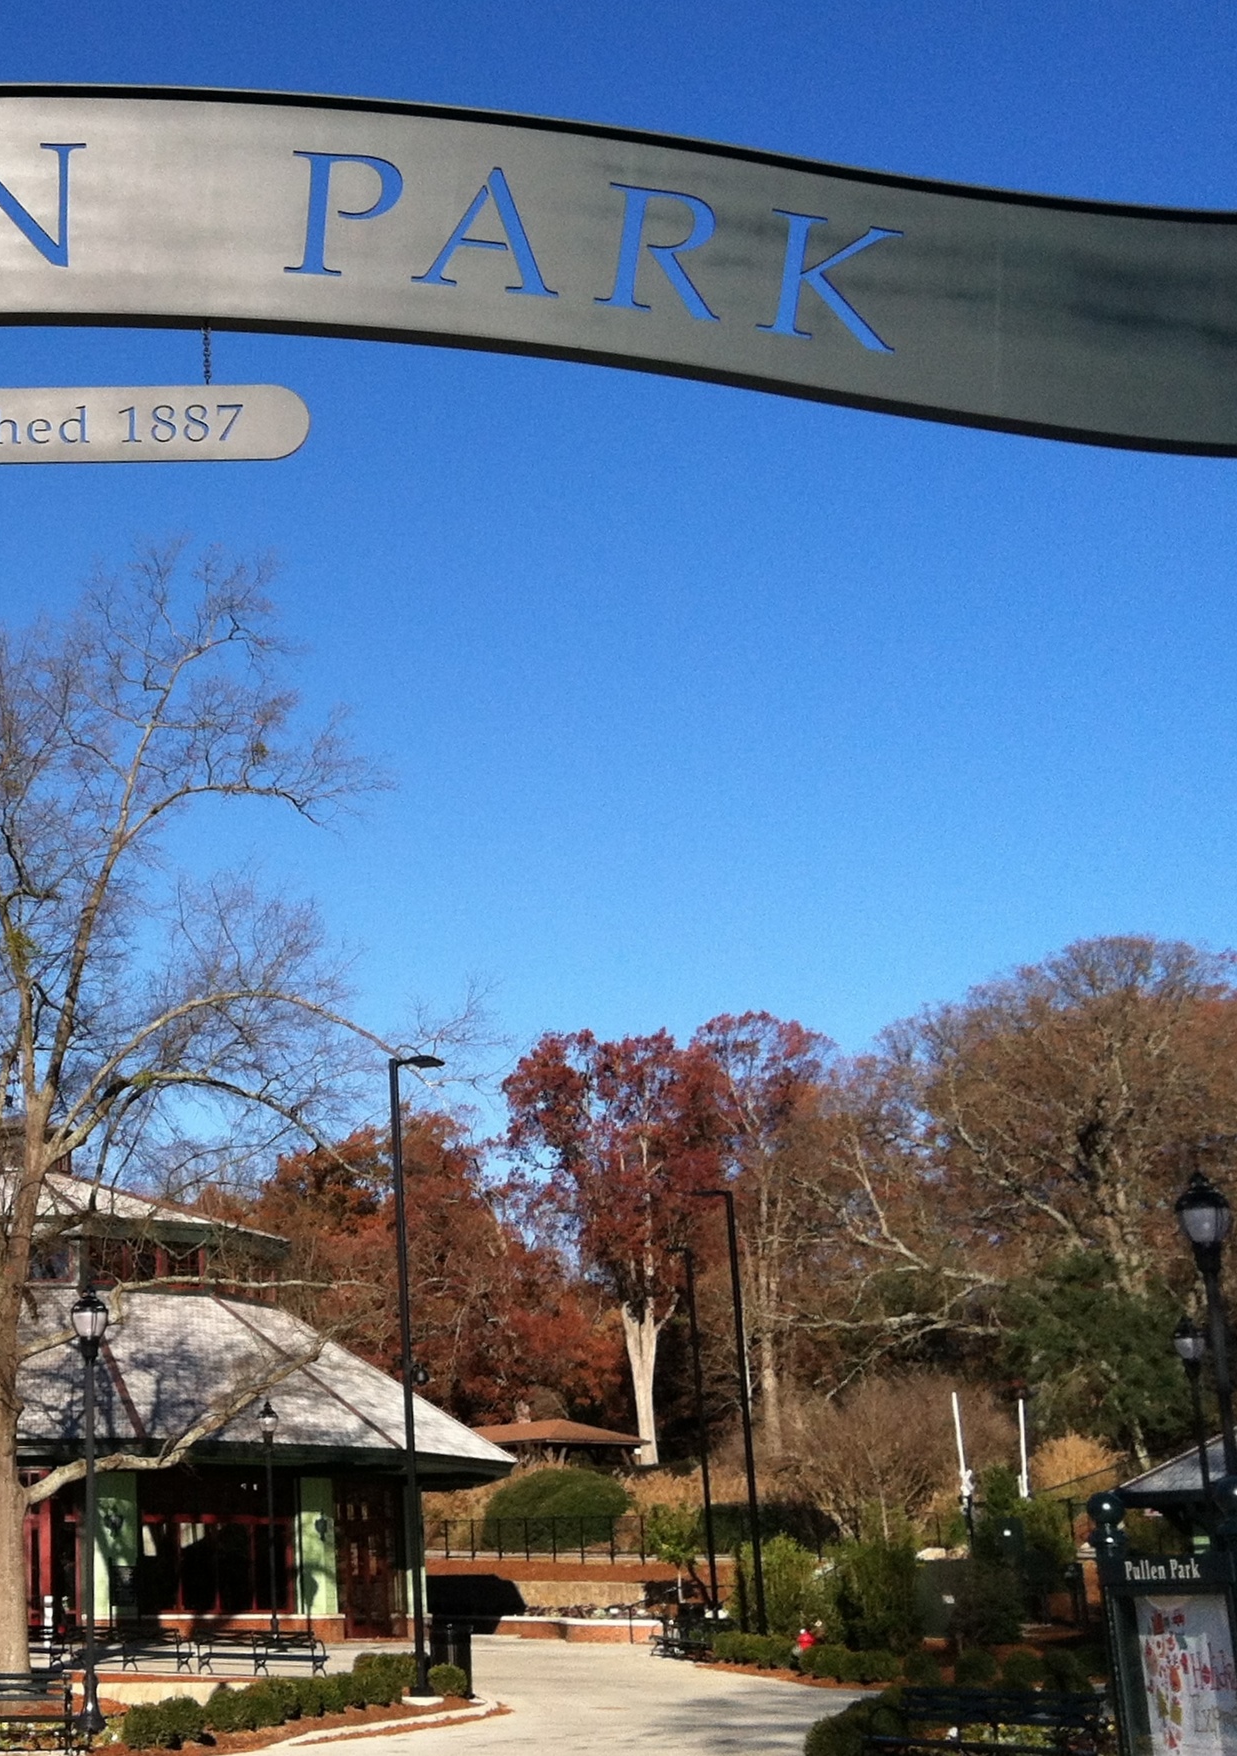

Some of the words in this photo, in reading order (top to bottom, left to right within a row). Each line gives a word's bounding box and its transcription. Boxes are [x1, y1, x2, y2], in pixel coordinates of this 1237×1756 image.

[282, 150, 905, 354] PARK
[117, 403, 245, 444] 1887
[1124, 1559, 1167, 1580] Pullen
[1169, 1557, 1201, 1579] Park
